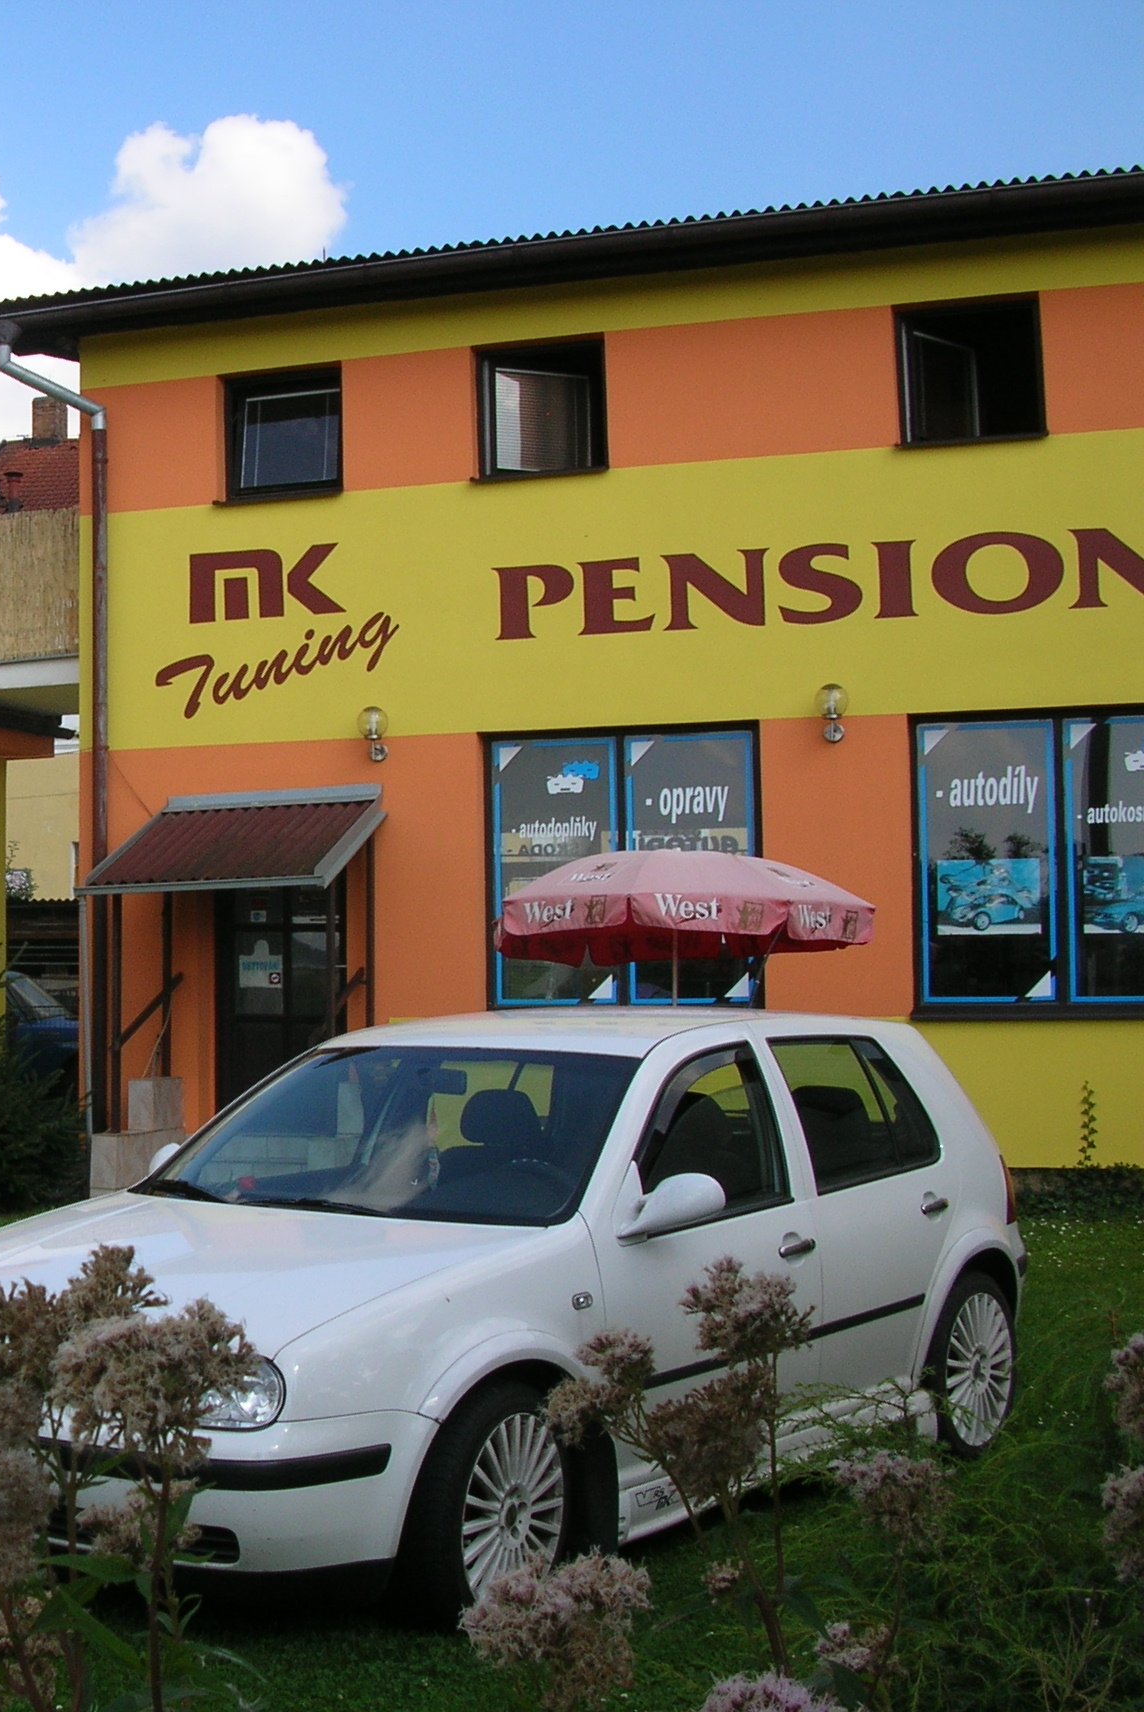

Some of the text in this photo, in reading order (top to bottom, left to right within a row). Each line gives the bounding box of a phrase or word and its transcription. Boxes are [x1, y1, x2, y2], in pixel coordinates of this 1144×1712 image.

[189, 542, 347, 624] MK
[491, 528, 1144, 641] PENSION
[155, 611, 400, 719] Tuning
[659, 785, 729, 823] opravy
[949, 765, 1039, 814] autodíly
[519, 815, 597, 842] autodoplňky
[1086, 800, 1144, 824] autokos
[524, 898, 574, 924] West
[653, 893, 721, 921] West
[798, 904, 832, 929] West
